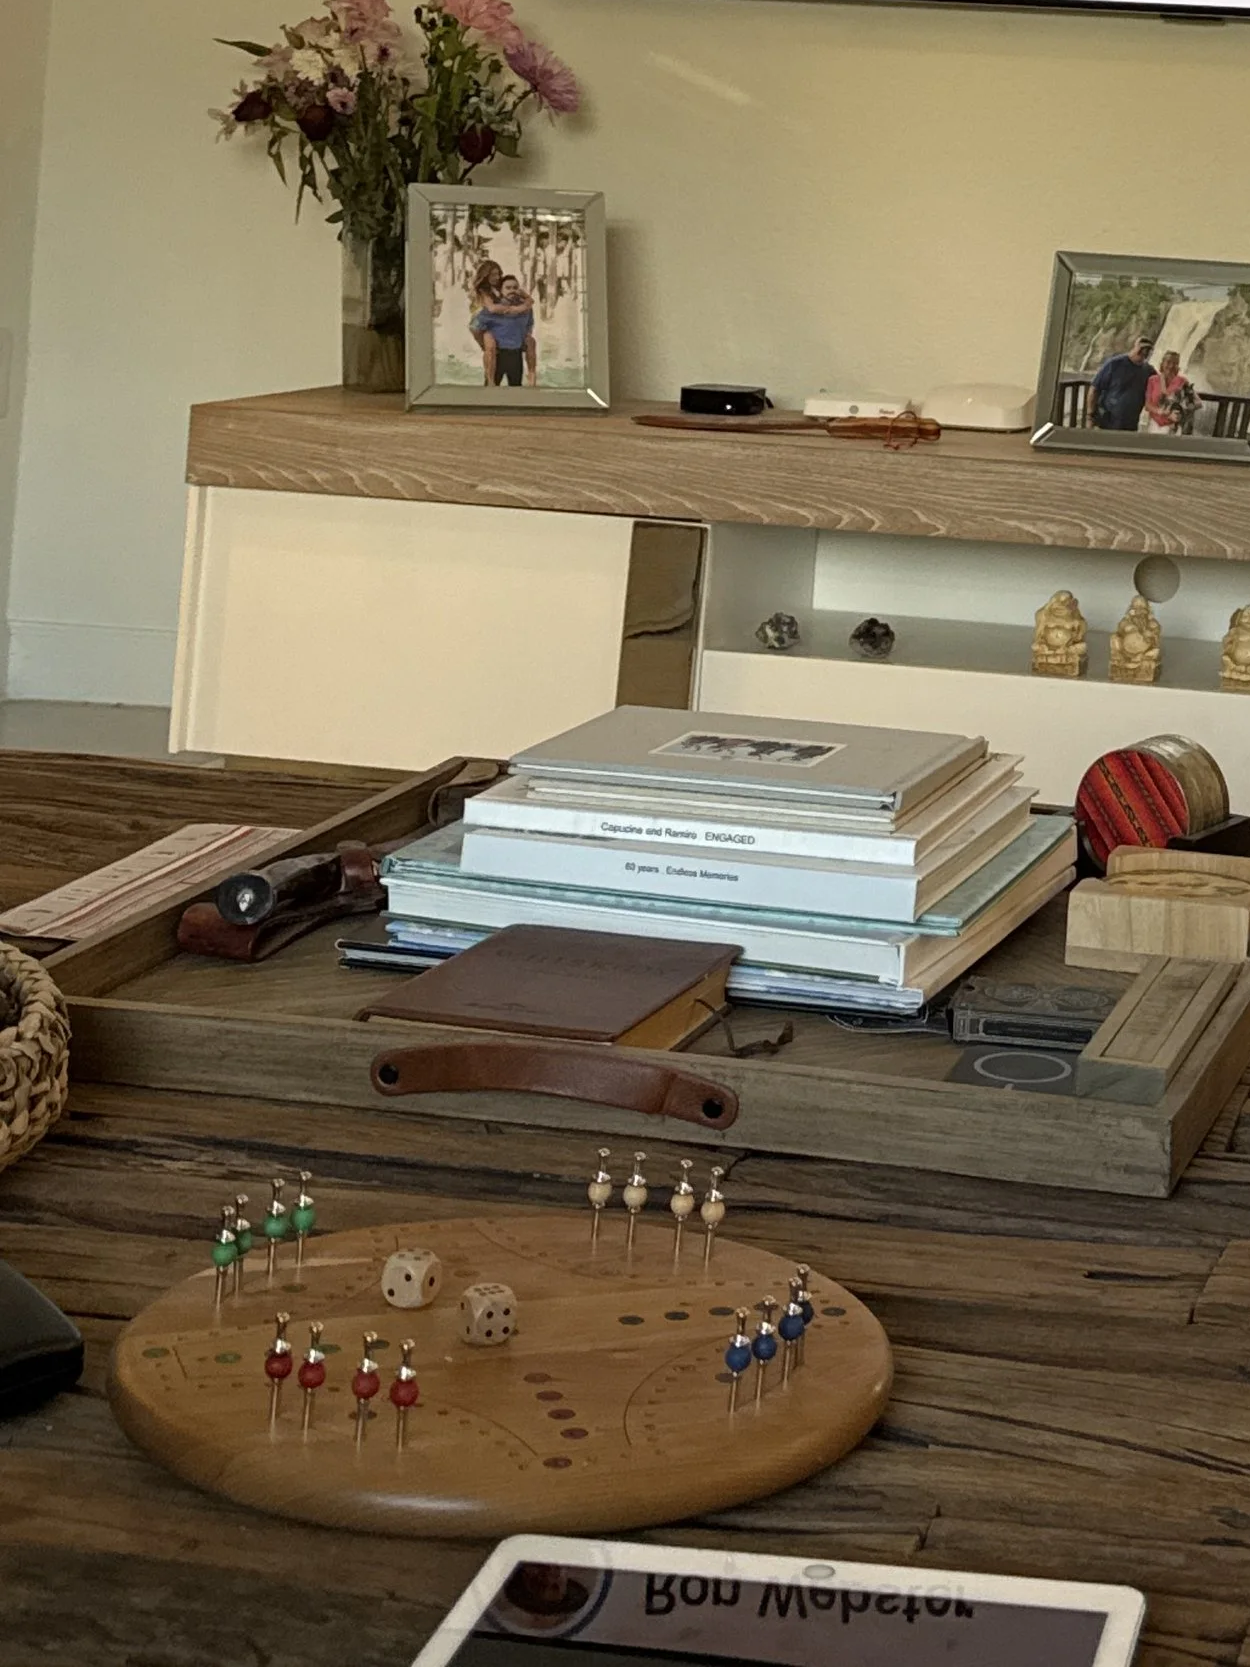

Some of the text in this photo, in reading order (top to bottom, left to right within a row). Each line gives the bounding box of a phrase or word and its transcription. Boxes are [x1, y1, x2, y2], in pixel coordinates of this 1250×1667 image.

[645, 827, 663, 836] and
[705, 831, 756, 846] ENGAGED
[638, 864, 659, 874] years
[700, 870, 739, 882] Memories
